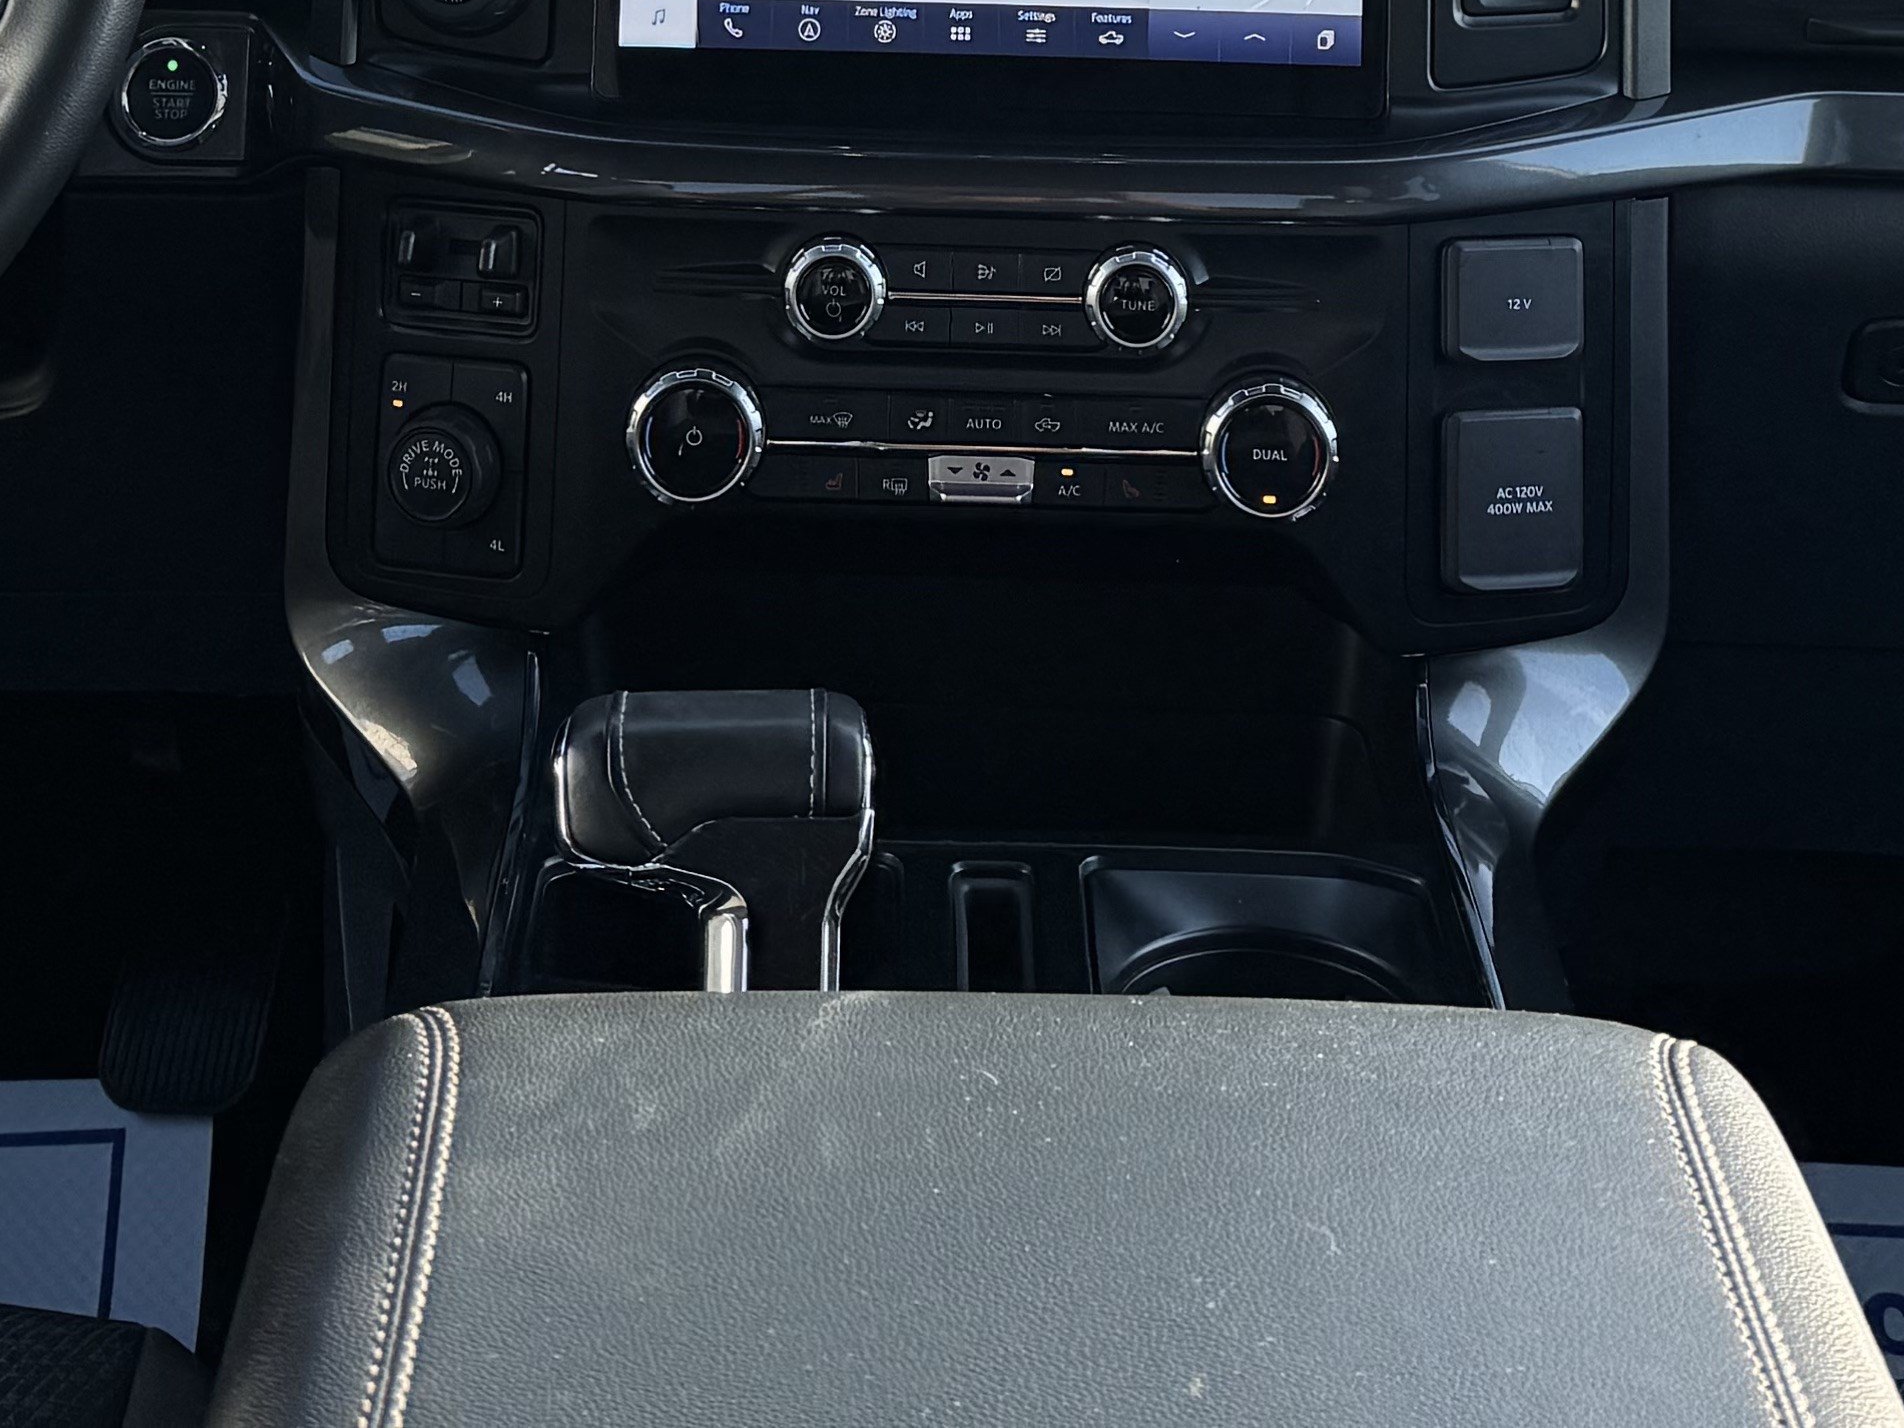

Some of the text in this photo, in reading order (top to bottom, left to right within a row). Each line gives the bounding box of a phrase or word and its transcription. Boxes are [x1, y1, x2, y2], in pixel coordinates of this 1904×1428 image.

[719, 2, 750, 14] Phone
[800, 4, 820, 15] Nav
[854, 5, 917, 20] Zone Lighting
[949, 8, 973, 21] Apps
[1017, 10, 1056, 24] Settings
[1091, 12, 1132, 25] Features
[148, 79, 196, 90] ENGINE
[152, 97, 191, 108] START
[155, 109, 188, 120] STOP
[821, 284, 846, 296] VOL
[1121, 300, 1156, 312] TUNE
[1507, 298, 1532, 311] 12 V
[391, 380, 408, 392] 2H
[496, 391, 512, 403] 4H
[966, 418, 1002, 431] AUTO
[1108, 421, 1165, 434] MAX A/C
[399, 439, 463, 476] DRIVE MODE
[1252, 448, 1288, 461] DUAL
[414, 477, 446, 490] PUSH
[1058, 485, 1081, 496] A/C
[1496, 485, 1544, 499] AC 120V
[1486, 500, 1554, 516] 400W MAX
[489, 539, 505, 552] 4L
